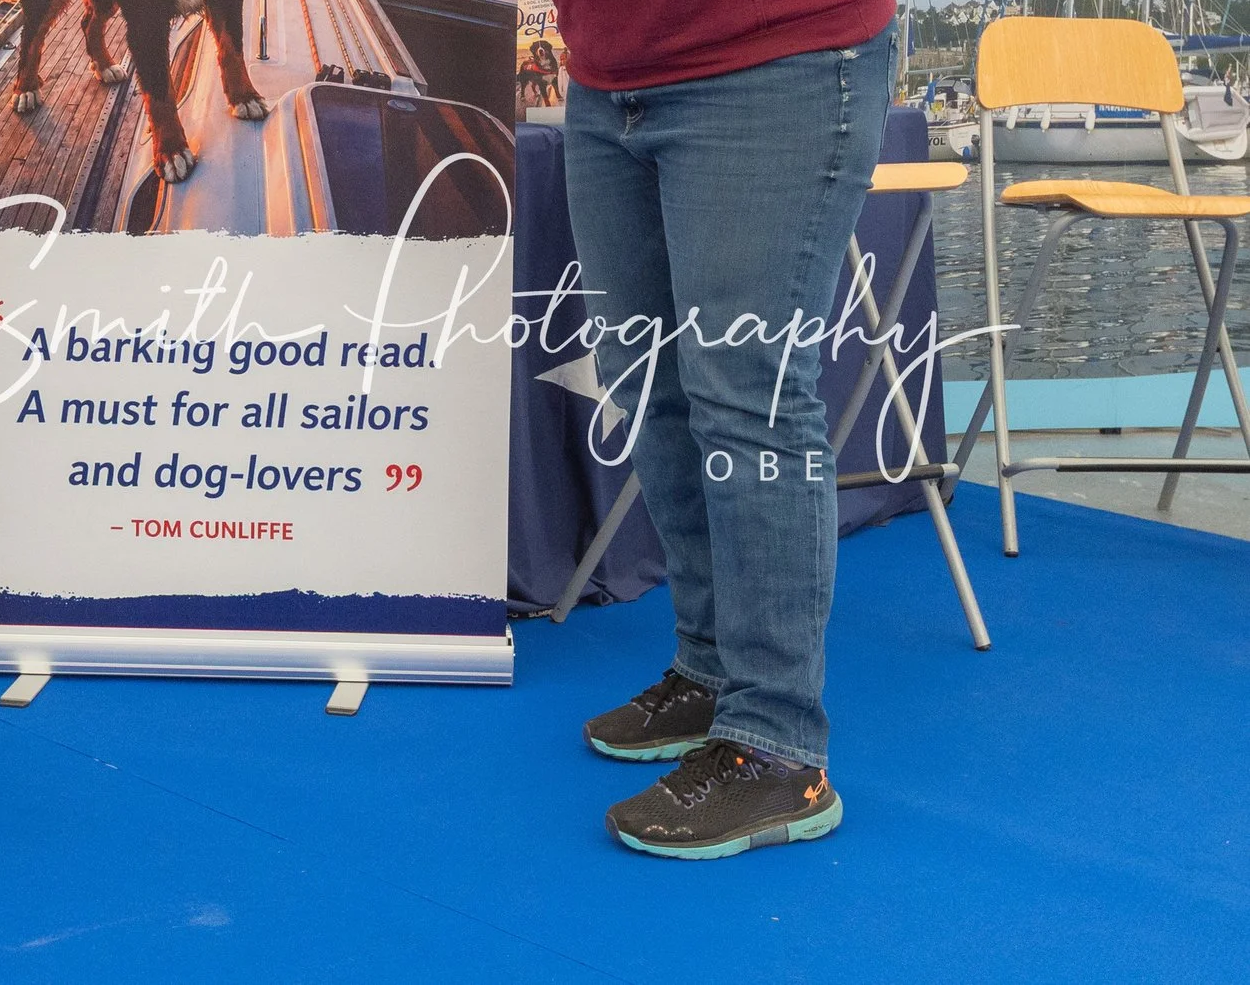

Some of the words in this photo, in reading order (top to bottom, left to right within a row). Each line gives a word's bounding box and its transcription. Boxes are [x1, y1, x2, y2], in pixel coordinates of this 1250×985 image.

[22, 328, 53, 362] A
[66, 330, 217, 375] barking
[229, 331, 326, 375] good
[340, 333, 437, 369] read.
[17, 389, 46, 424] A
[60, 394, 158, 426] must
[170, 390, 229, 428] for
[241, 392, 287, 430] all
[300, 394, 430, 432] sailors
[68, 451, 141, 488] and
[154, 452, 362, 500] dog-lovers
[131, 519, 183, 539] TOM
[189, 519, 294, 541] CUNLIFFE
